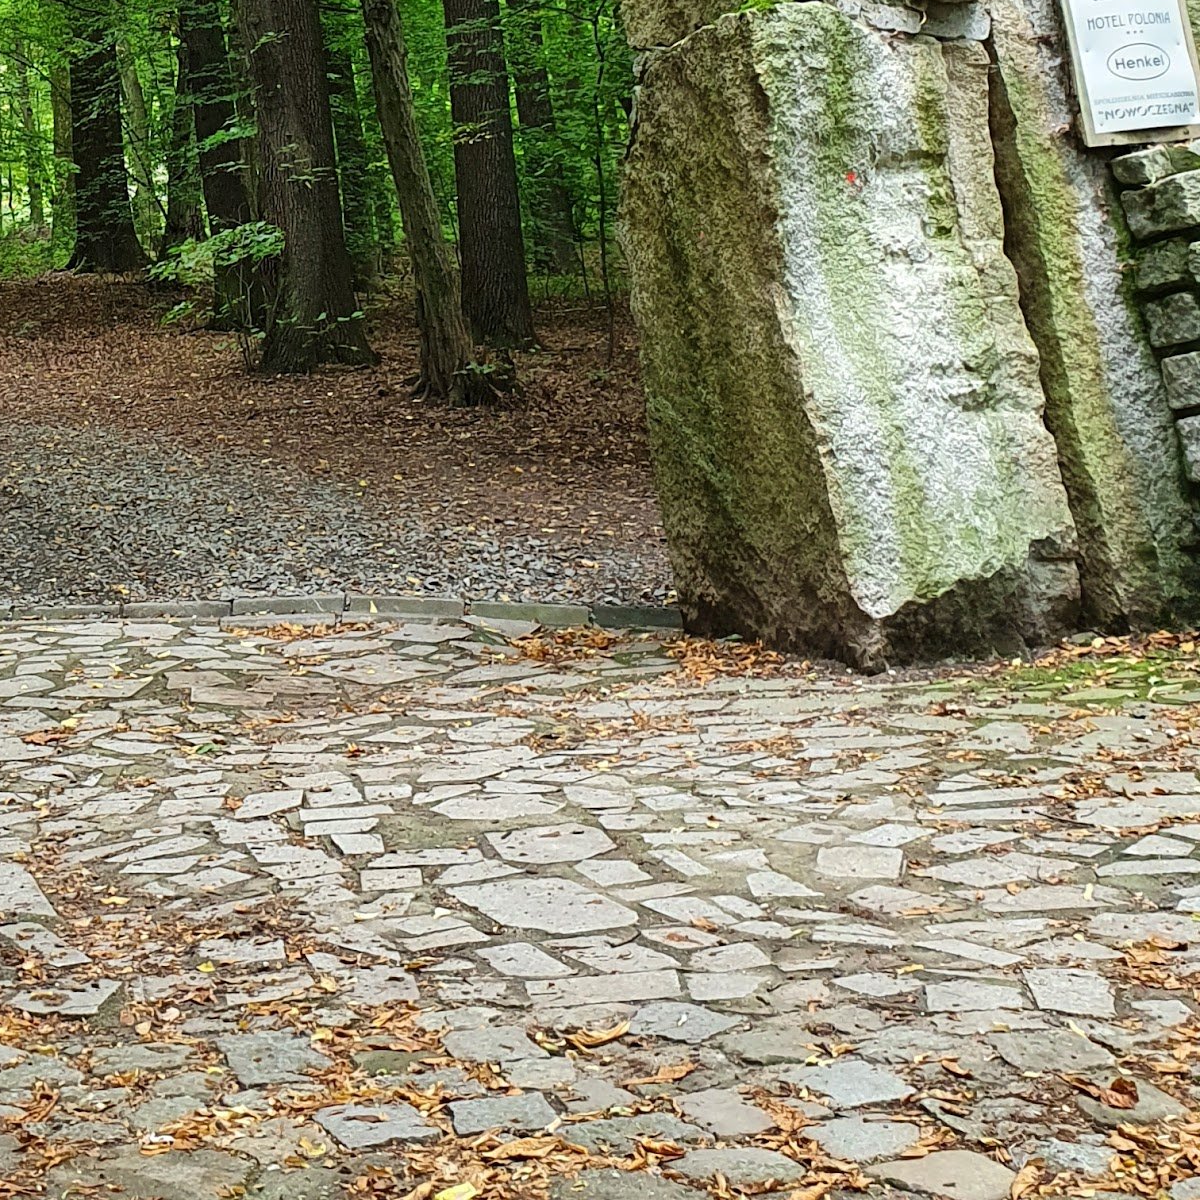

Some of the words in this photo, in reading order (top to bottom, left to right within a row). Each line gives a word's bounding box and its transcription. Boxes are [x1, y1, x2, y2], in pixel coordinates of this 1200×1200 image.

[1087, 14, 1126, 30] HOTEL
[1128, 11, 1171, 25] POLONIA
[1115, 54, 1165, 70] Henkel
